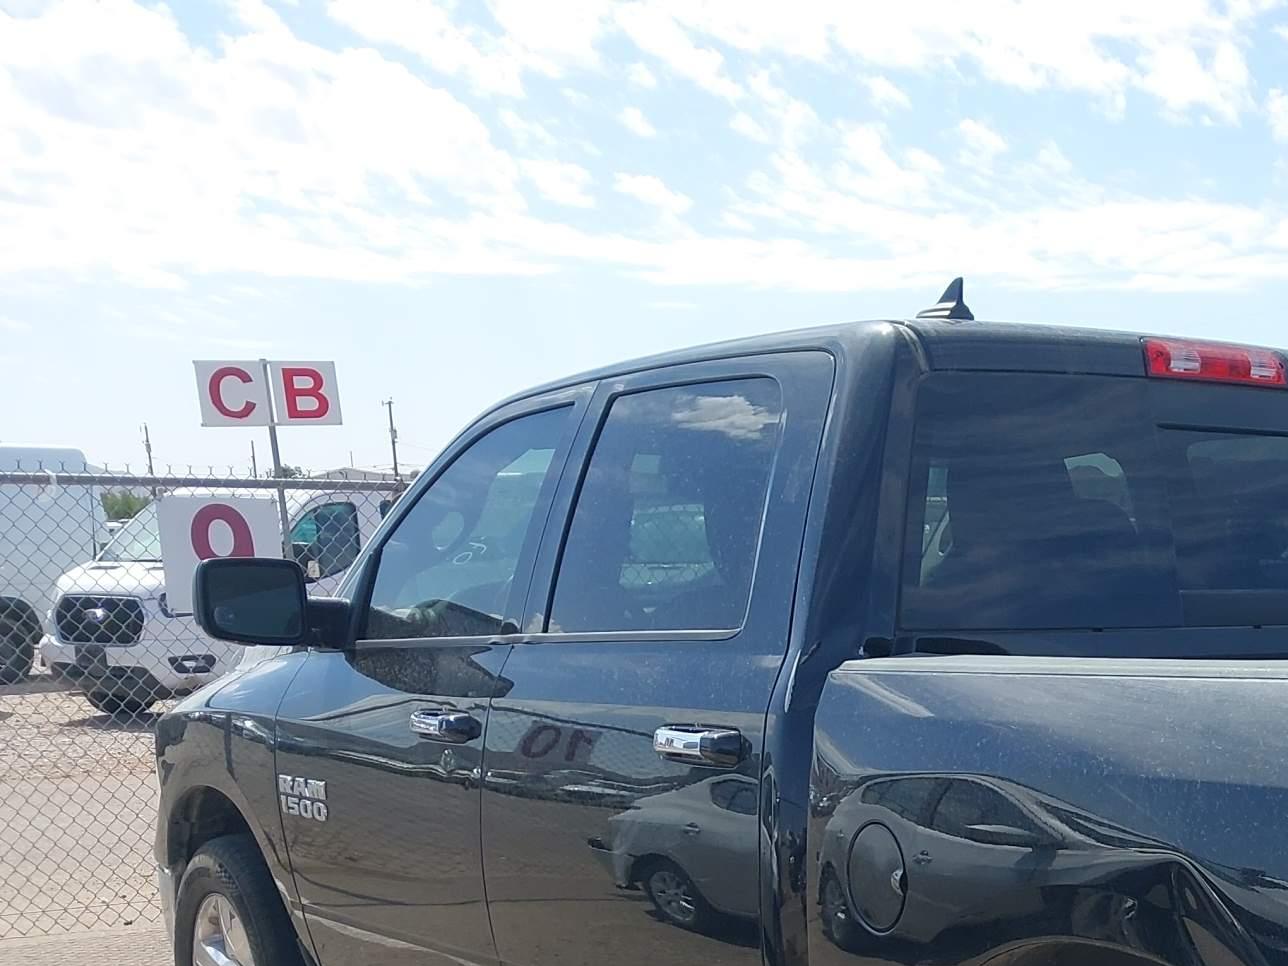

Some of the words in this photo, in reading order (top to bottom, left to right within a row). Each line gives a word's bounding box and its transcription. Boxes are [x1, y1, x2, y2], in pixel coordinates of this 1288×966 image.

[208, 366, 257, 419] C
[281, 367, 330, 419] B
[278, 774, 327, 801] RAM
[280, 794, 329, 822] 1500
